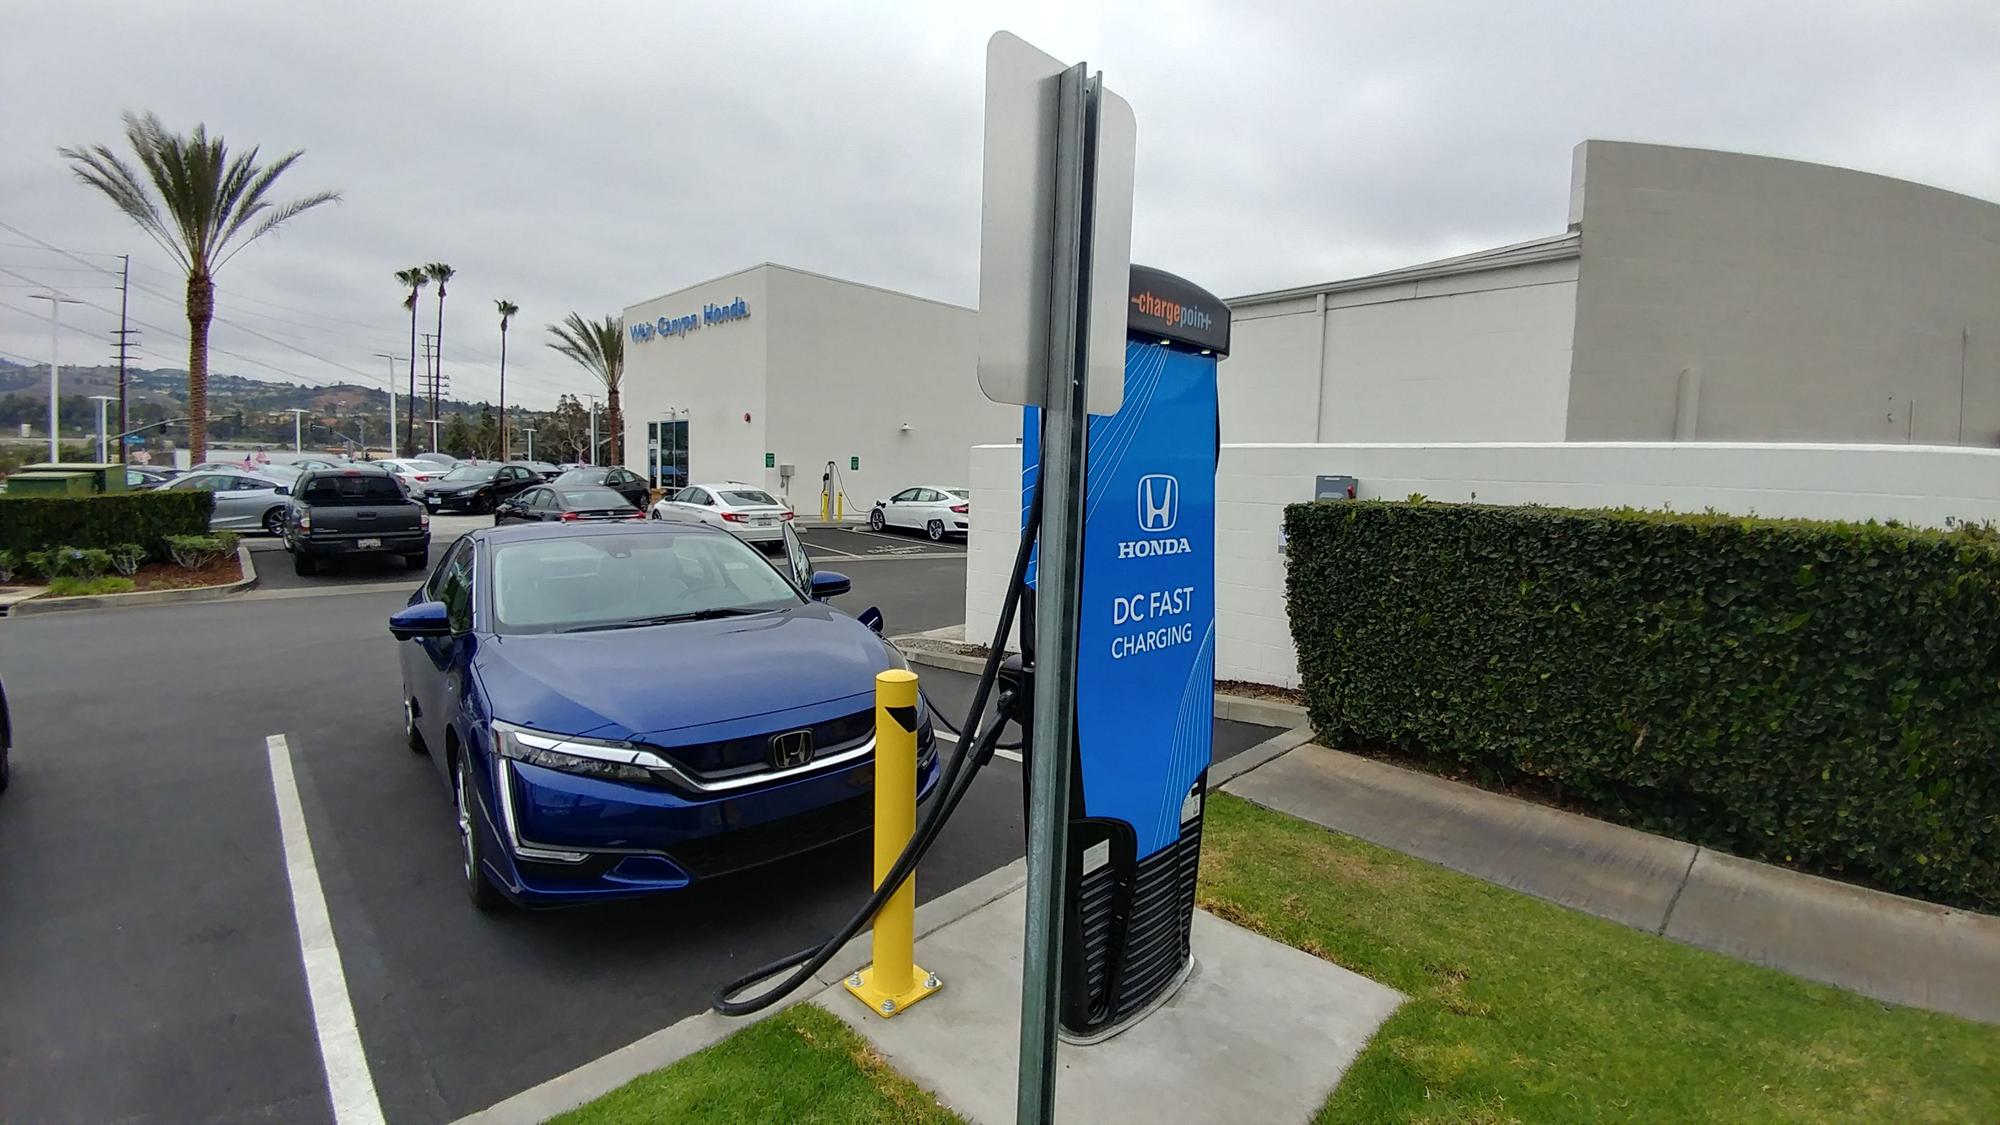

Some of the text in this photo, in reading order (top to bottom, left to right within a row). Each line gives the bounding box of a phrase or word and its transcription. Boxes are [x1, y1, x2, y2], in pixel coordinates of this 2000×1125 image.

[657, 313, 700, 339] Canyon
[703, 297, 748, 325] Honda
[1133, 291, 1212, 331] chargepoint
[1118, 537, 1191, 559] HONDA
[1113, 587, 1194, 625] DC FAST
[1111, 623, 1192, 659] CHARGING
